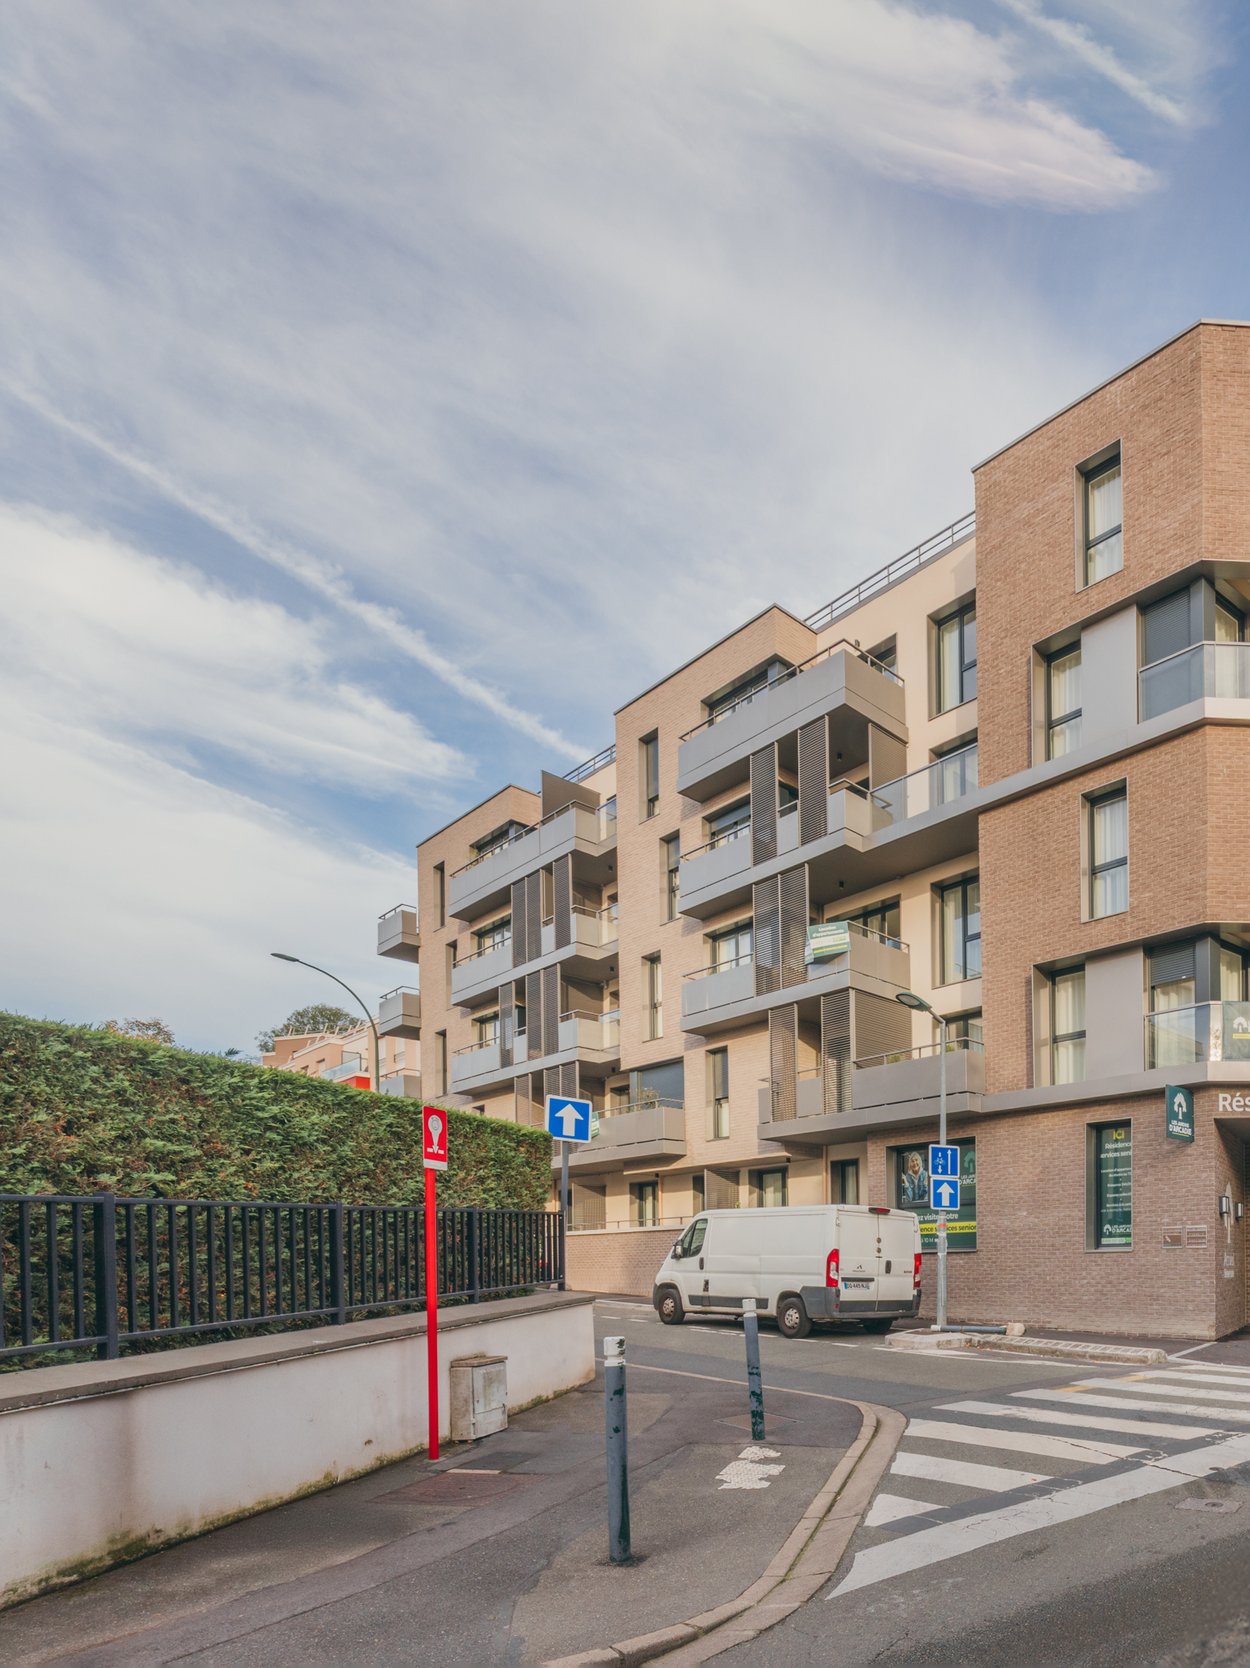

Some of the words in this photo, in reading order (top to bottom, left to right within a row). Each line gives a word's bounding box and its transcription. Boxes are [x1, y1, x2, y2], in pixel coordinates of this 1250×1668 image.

[1104, 1141, 1132, 1150] Résidenc
[1100, 1151, 1120, 1159] ervices
[946, 1212, 959, 1220] otre
